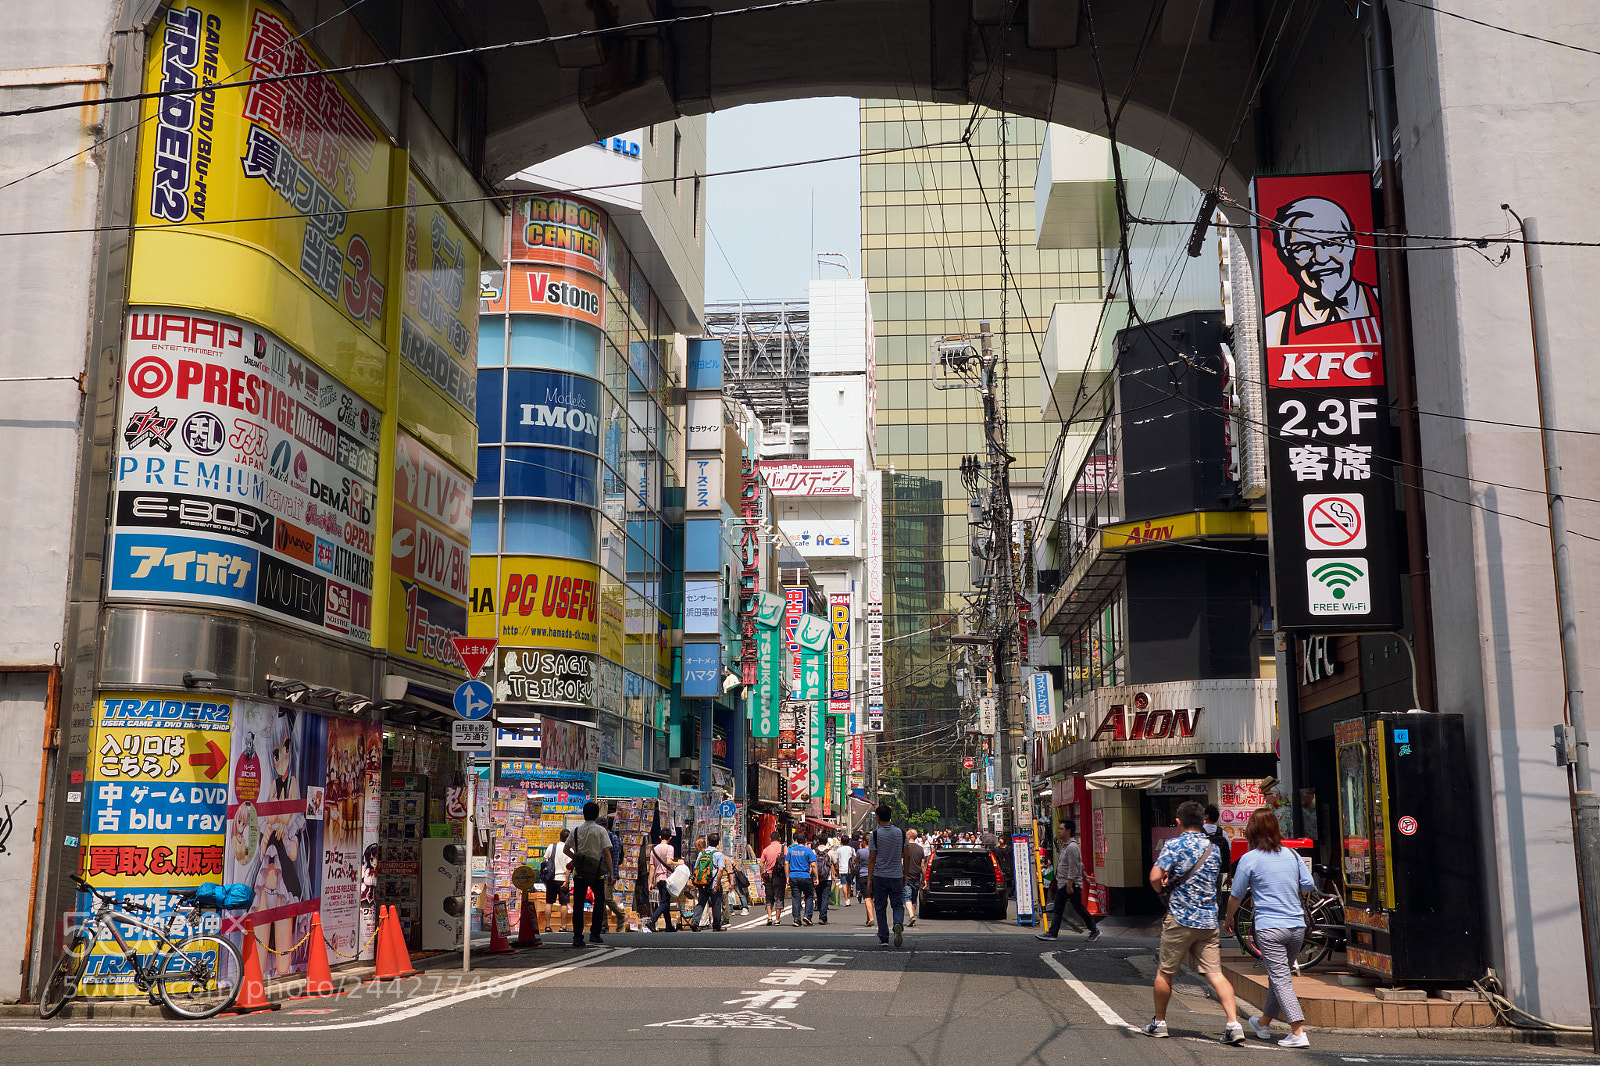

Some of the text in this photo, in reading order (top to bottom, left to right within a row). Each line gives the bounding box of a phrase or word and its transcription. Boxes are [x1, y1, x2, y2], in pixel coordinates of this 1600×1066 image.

[152, 8, 201, 223] TRADER2
[613, 137, 640, 156] BLD
[529, 199, 600, 234] ROBOT
[431, 211, 466, 285] ゲーム
[526, 224, 601, 261] CENTER
[300, 222, 345, 303] 当店
[343, 233, 385, 328] 3F
[431, 254, 463, 313] DVD
[527, 271, 599, 317] Vstone
[417, 275, 471, 360] Blu-ray
[400, 315, 476, 417] TRADER2
[1278, 352, 1372, 381] KFC
[176, 359, 295, 437] PRESTIGE
[545, 387, 586, 409] Models
[520, 403, 599, 440] IMON
[689, 425, 720, 433] セラサイン
[1278, 398, 1378, 439] 2,3F
[120, 457, 264, 503] PREMIUM
[235, 453, 264, 471] JAPAN
[1288, 444, 1373, 483] 客席
[697, 461, 709, 507] アースニクス
[343, 520, 375, 556] OPPAI
[130, 546, 251, 588] アイポケ
[334, 545, 374, 591] ATTACKERS
[264, 564, 321, 617] MUTEKI
[502, 573, 538, 617] PC
[830, 595, 849, 604] 24H
[1313, 602, 1367, 612] FREE Wi-Fi
[461, 645, 489, 655] 止まれ
[522, 652, 589, 677] USAGI
[508, 675, 593, 701] TEIKOKU
[685, 668, 717, 681] ハマダ
[758, 630, 771, 736] TSUKUMO
[103, 698, 232, 723] TRADER2
[100, 734, 185, 757] 入り口は
[455, 733, 489, 741] 一方通行
[130, 786, 186, 804] ゲーム
[190, 787, 227, 804] DVD
[89, 844, 224, 876] 買取&販売
